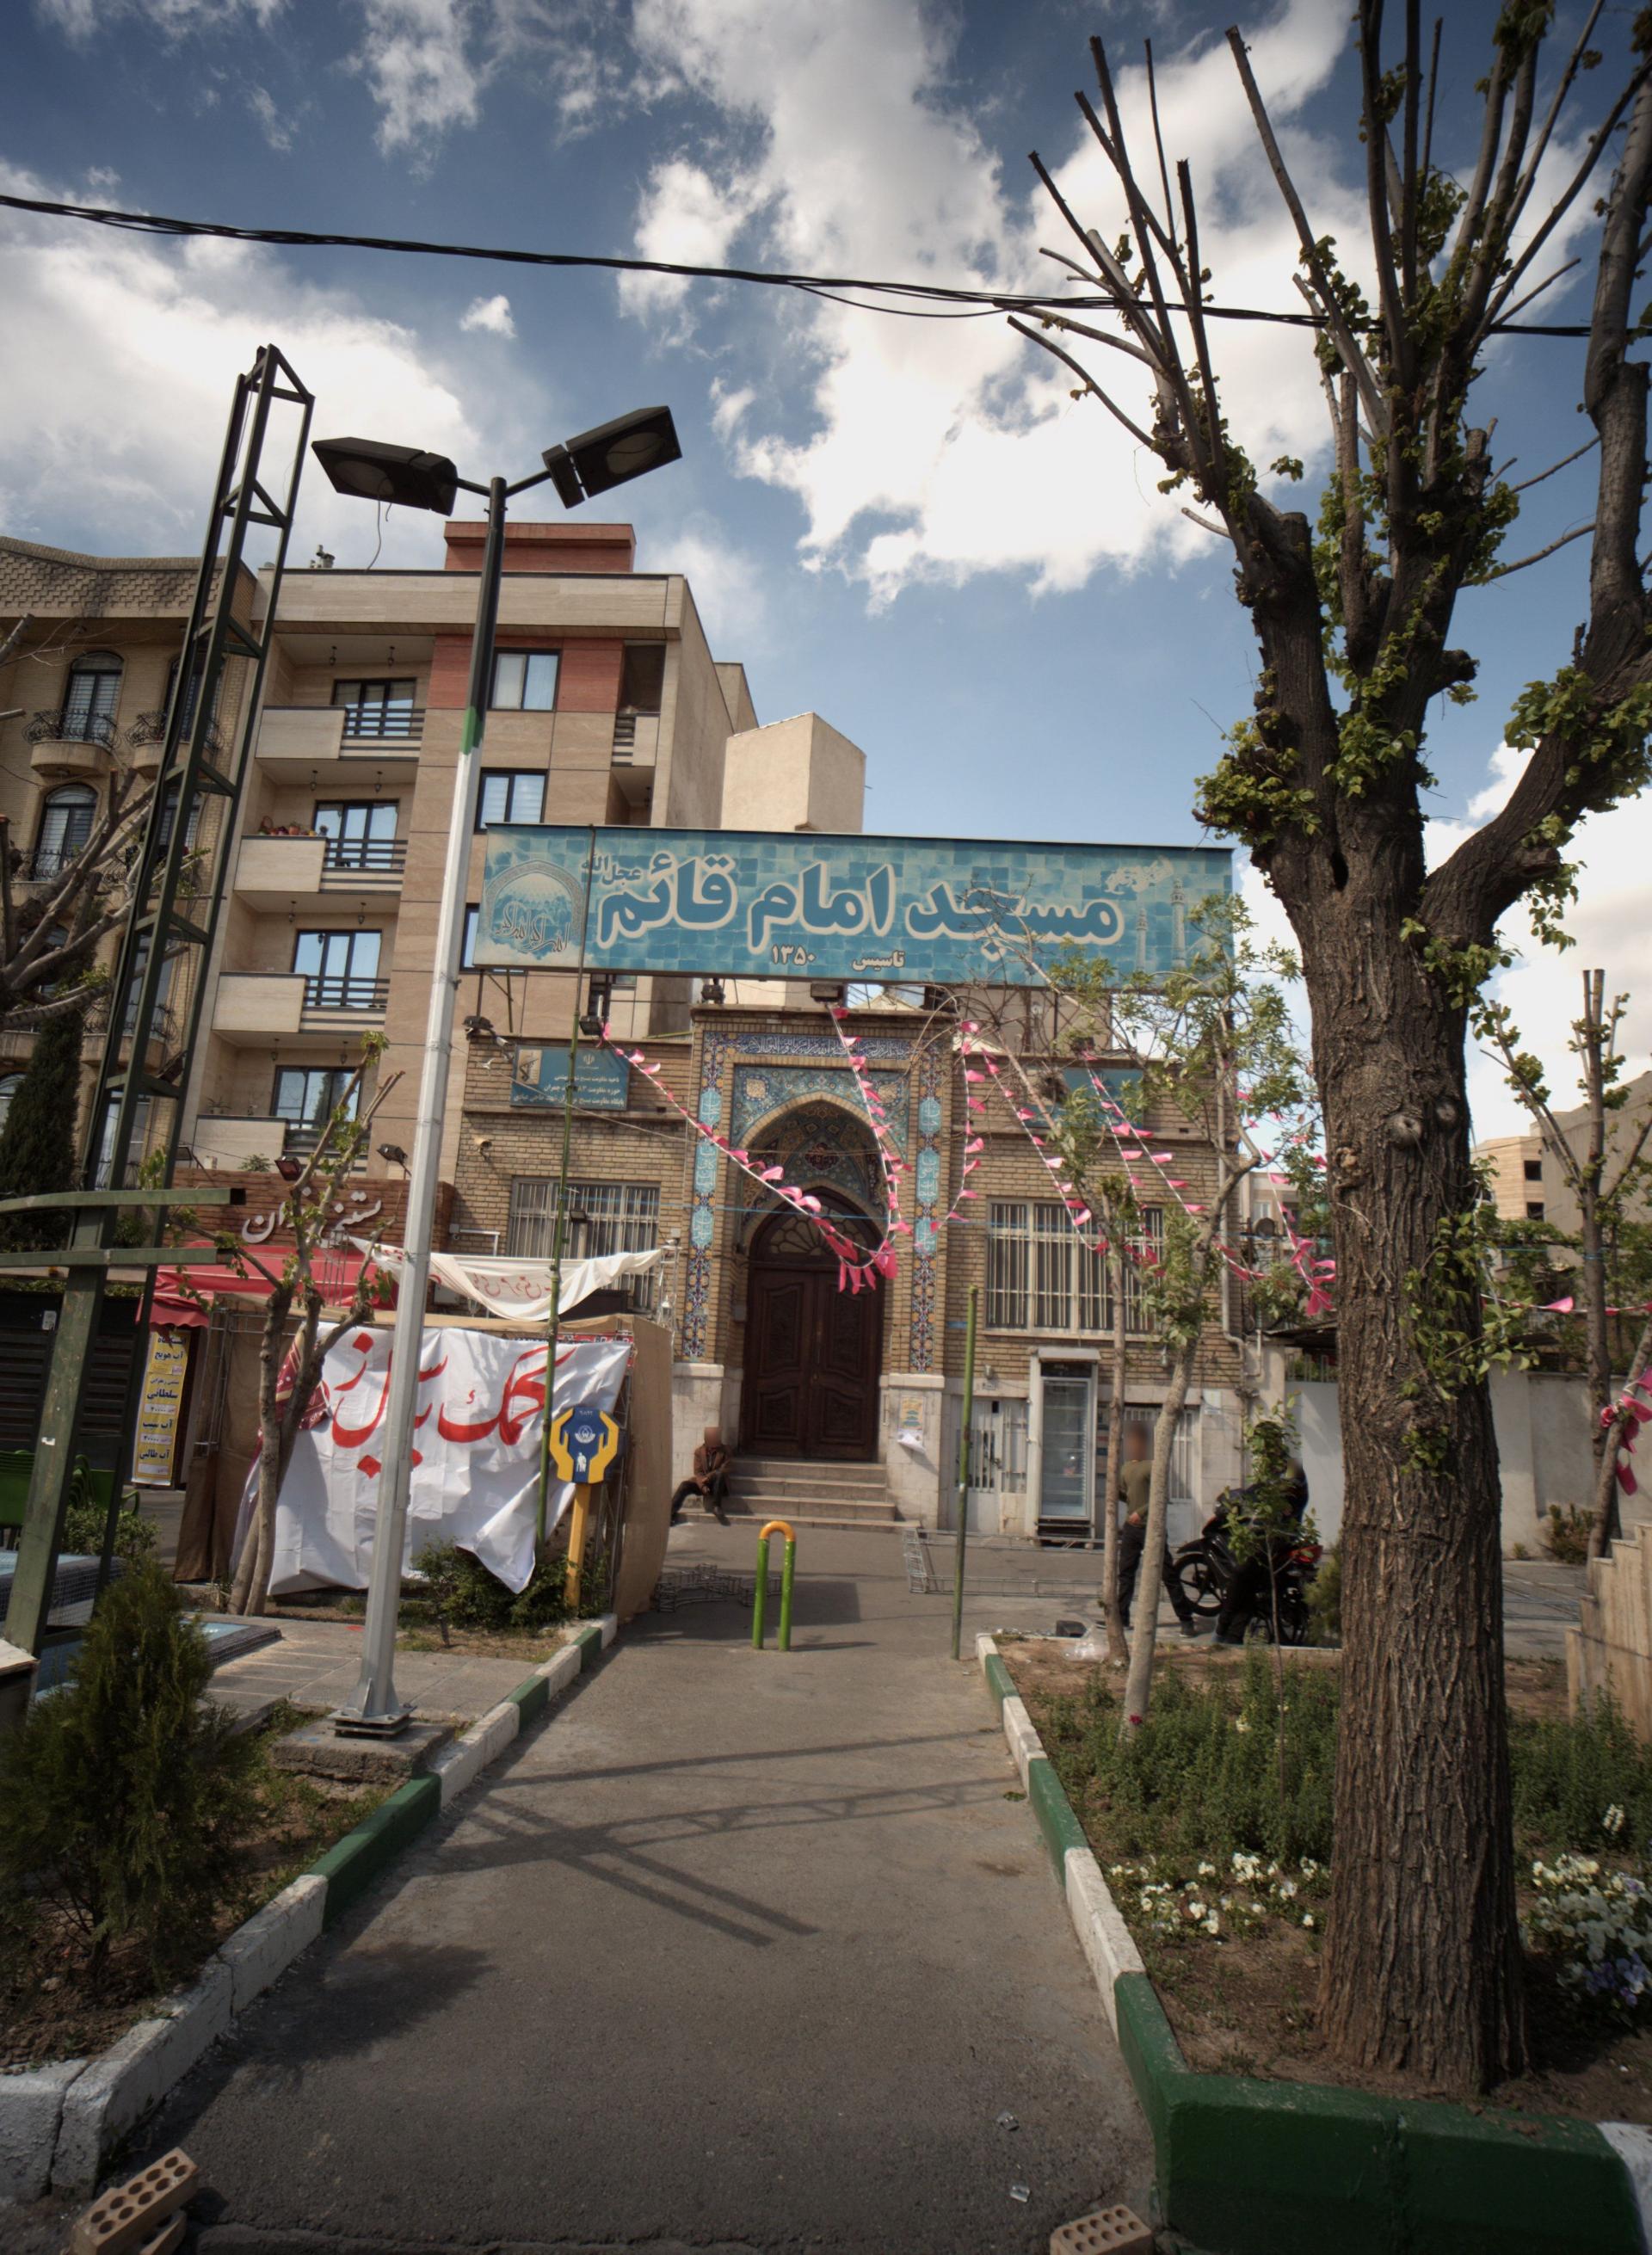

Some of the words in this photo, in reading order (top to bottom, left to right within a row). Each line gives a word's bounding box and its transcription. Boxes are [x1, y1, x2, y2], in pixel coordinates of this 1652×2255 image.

[598, 850, 738, 950] قائم
[747, 859, 896, 954] امام
[905, 881, 1124, 961] مسجد
[771, 944, 817, 965] ۱۳۵۰
[851, 950, 906, 972] تاسیس
